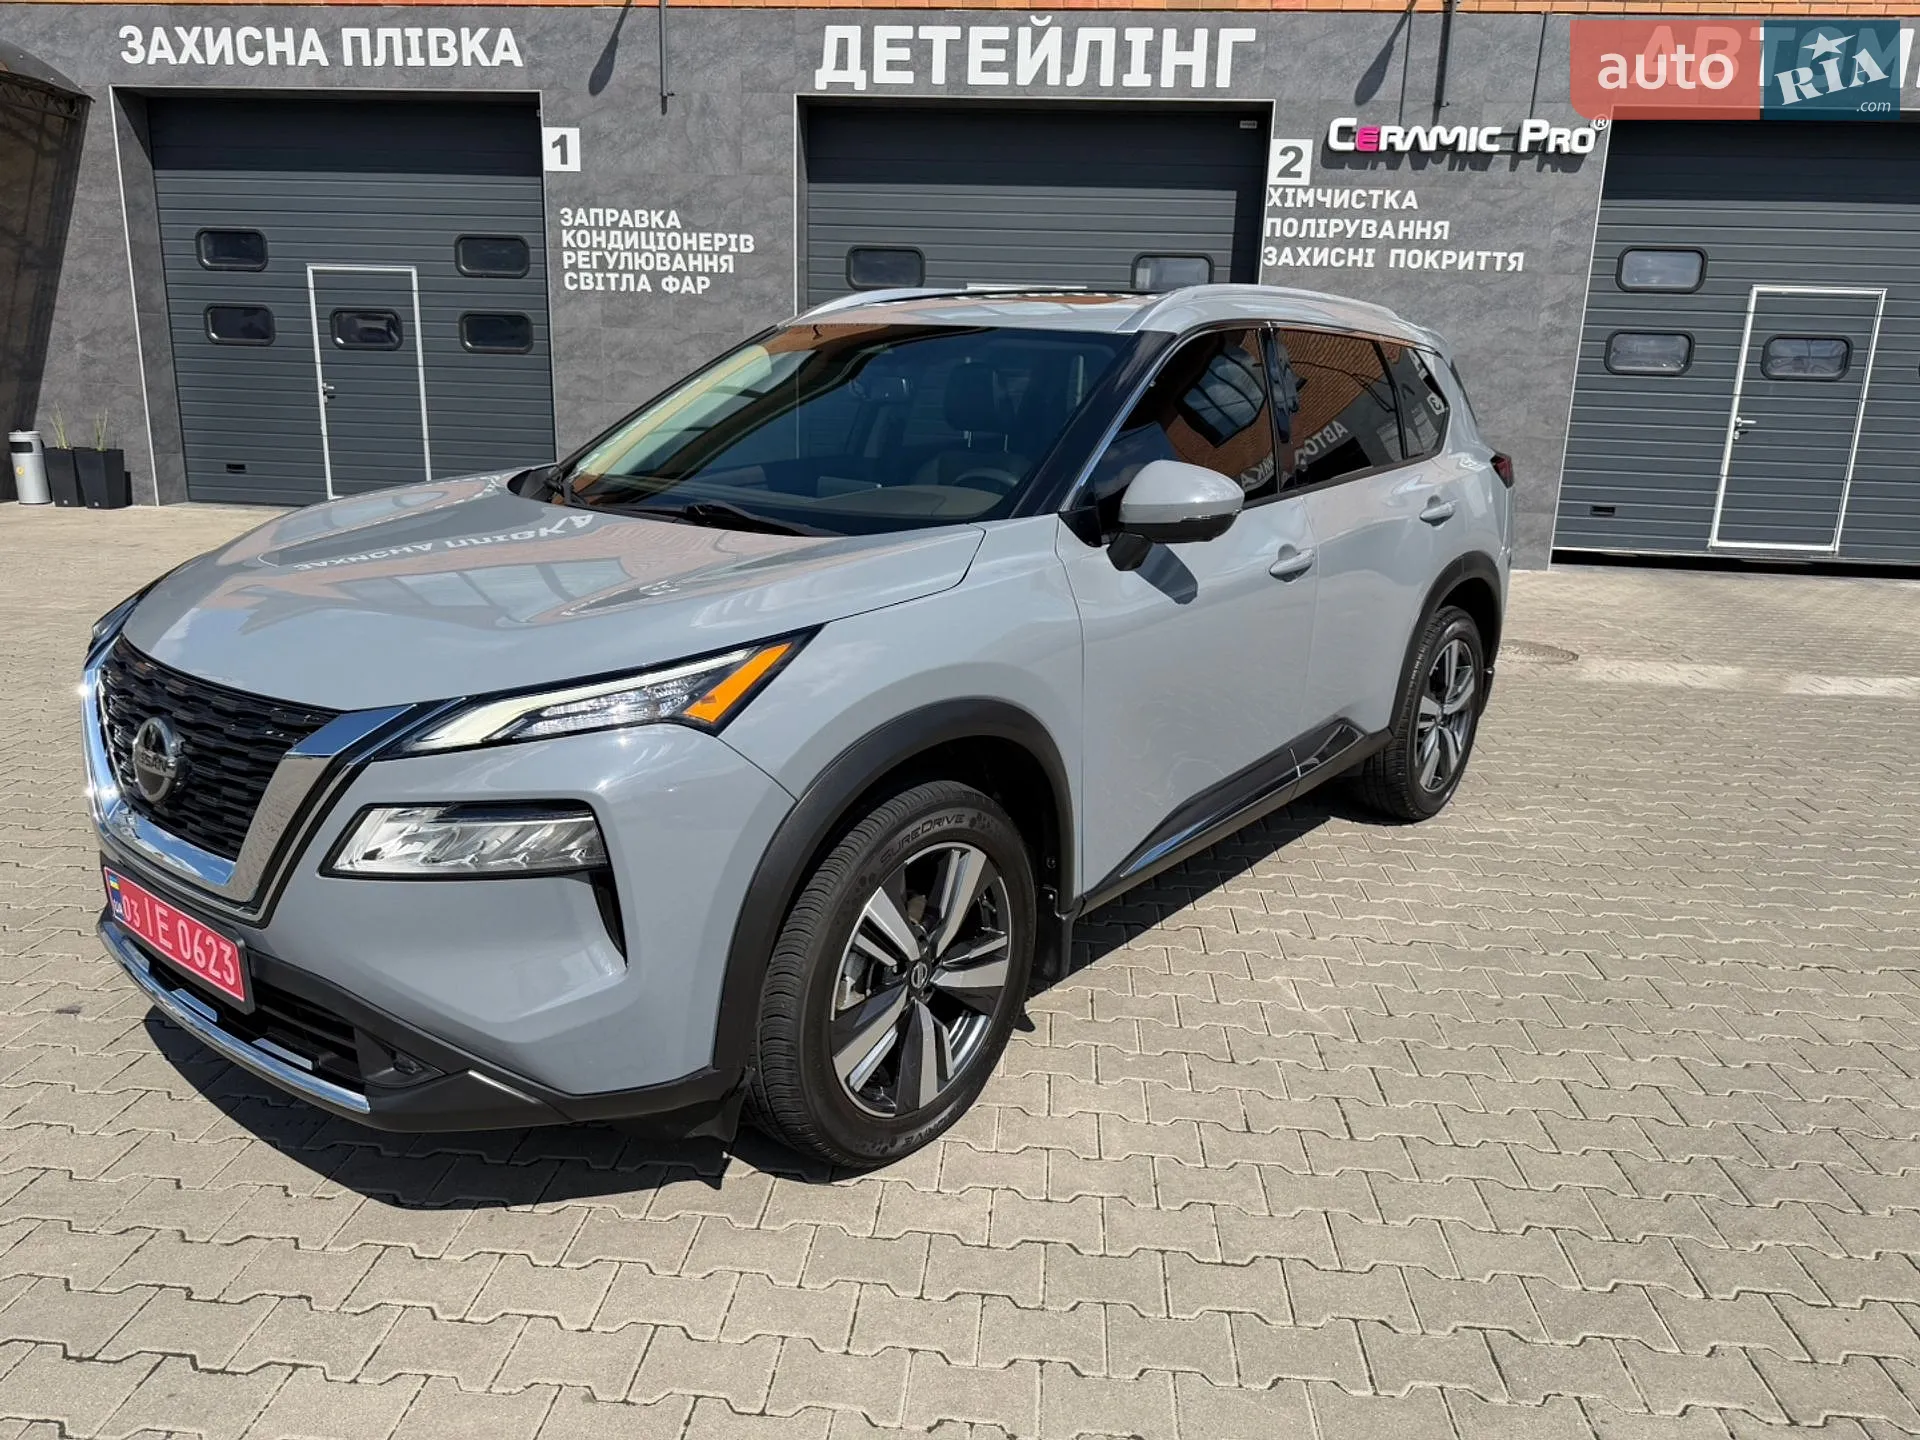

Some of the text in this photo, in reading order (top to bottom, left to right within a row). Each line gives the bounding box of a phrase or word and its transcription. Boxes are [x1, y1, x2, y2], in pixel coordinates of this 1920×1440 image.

[118, 25, 524, 67] ЗАХИСНА ПЛІВКА
[815, 15, 1256, 91] ДЕТЕЙЛІНГ
[551, 134, 568, 165] 1
[1276, 145, 1304, 178] 2
[1267, 187, 1419, 210] ХІМЧИСТКА
[559, 207, 682, 229] ЗАПРАВКА
[1264, 217, 1450, 241] ПОЛІРУВАННЯ
[561, 229, 755, 253] КОНДИЦІОНЕРІВ
[562, 250, 734, 273] РЕГУЛЮВАННЯ
[1263, 246, 1524, 272] ЗАХИСНІ ПОКРИТТЯ
[563, 272, 711, 294] СВІТЛА ФАР
[122, 895, 235, 986] 03 IE 0623
